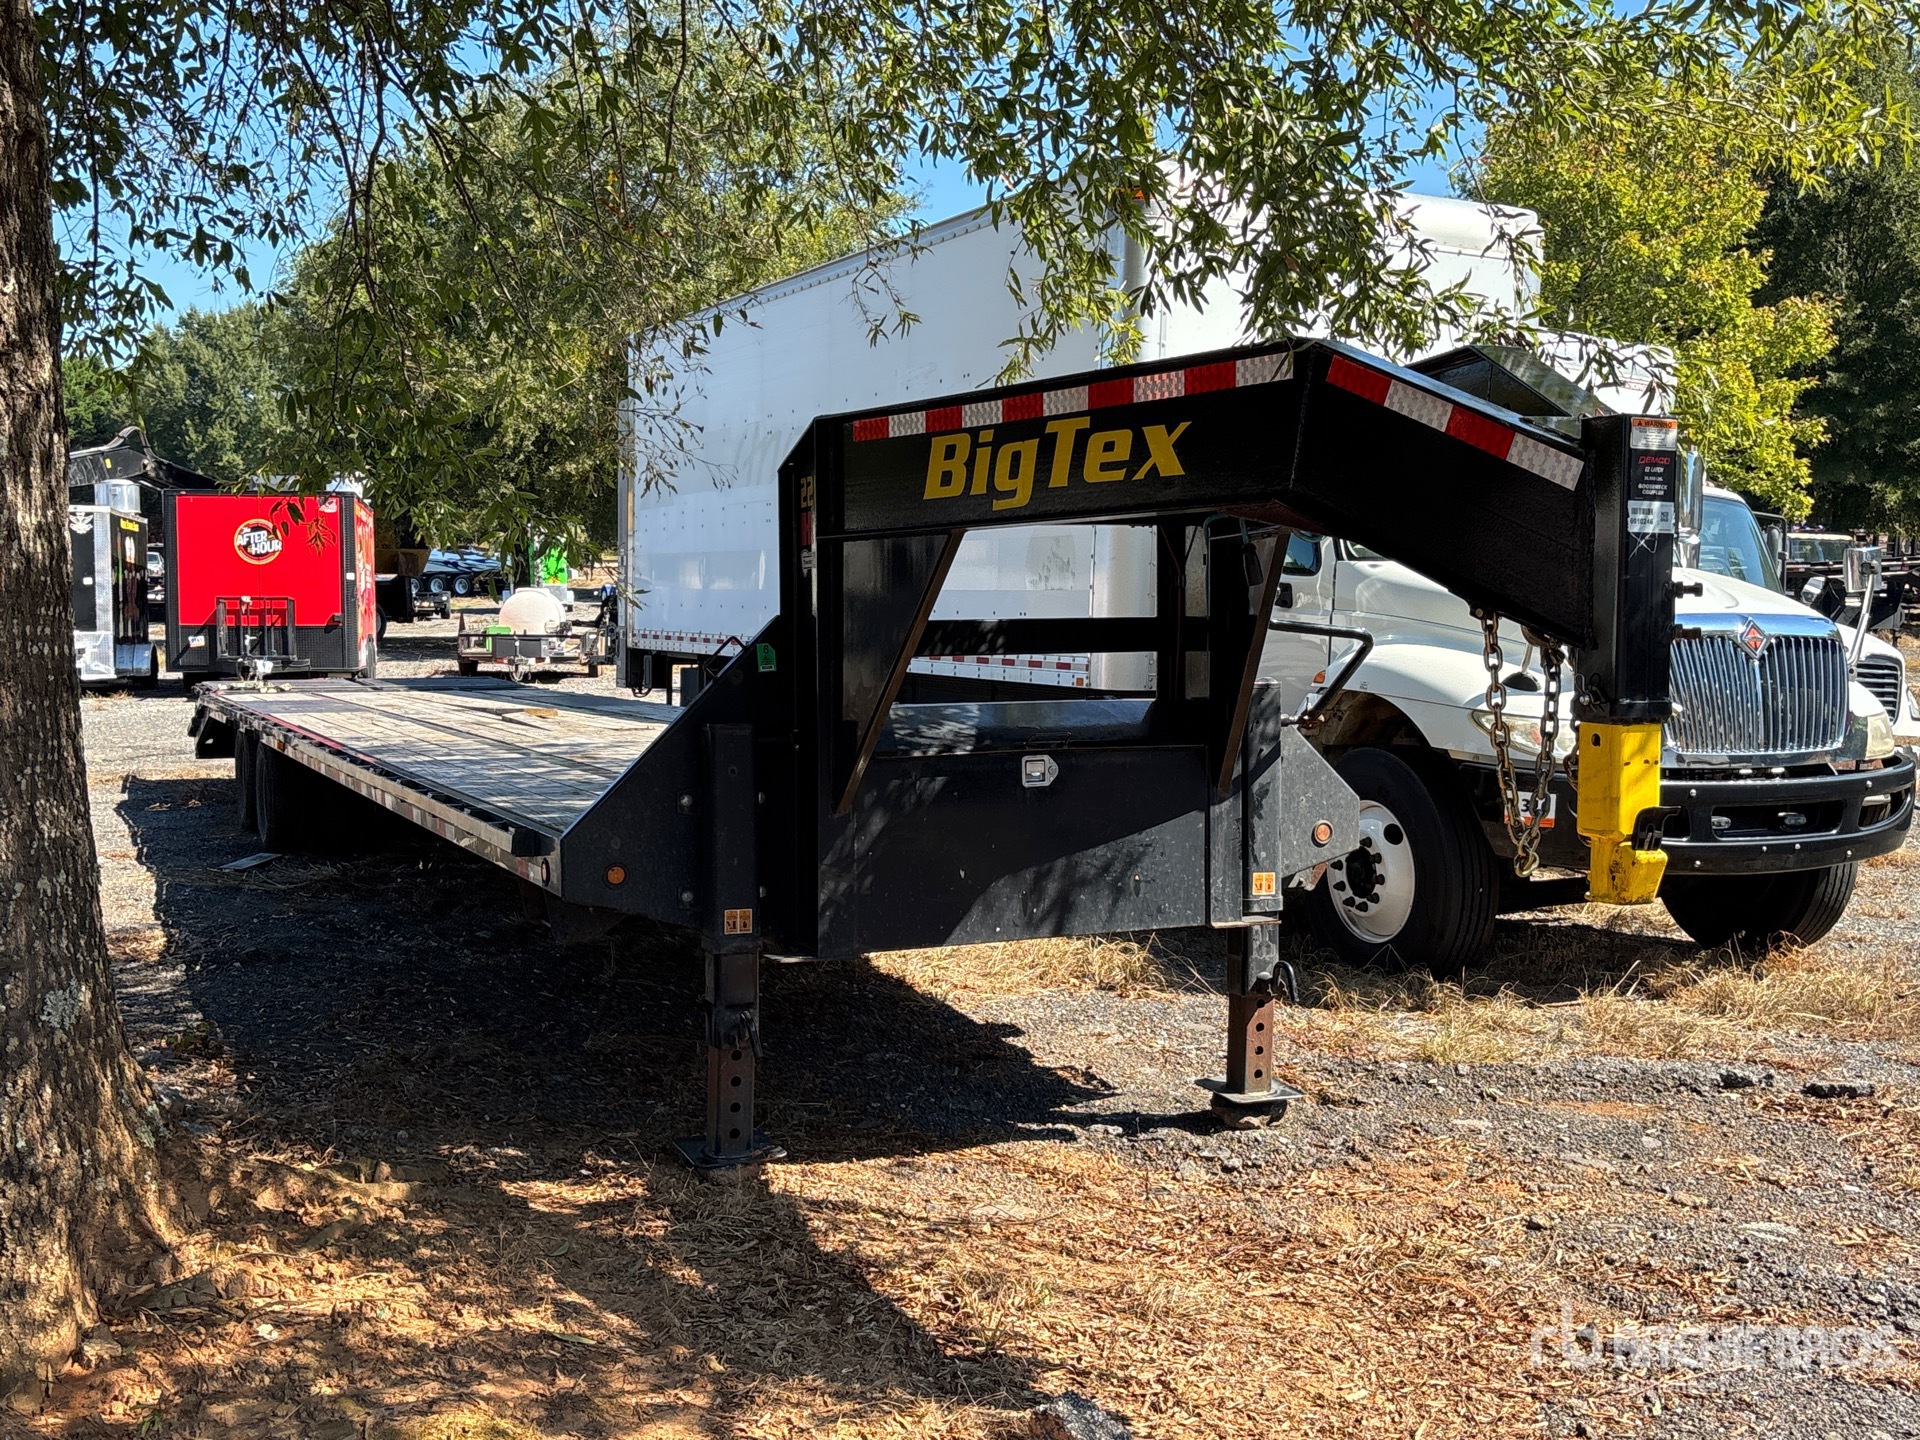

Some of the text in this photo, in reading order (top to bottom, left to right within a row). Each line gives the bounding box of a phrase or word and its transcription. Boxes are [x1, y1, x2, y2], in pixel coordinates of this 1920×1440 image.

[1645, 420, 1673, 429] WARNING
[923, 416, 1192, 511] BigTex
[1638, 456, 1670, 464] DEMCO
[237, 531, 267, 546] AFTER
[252, 540, 282, 555] HOUR
